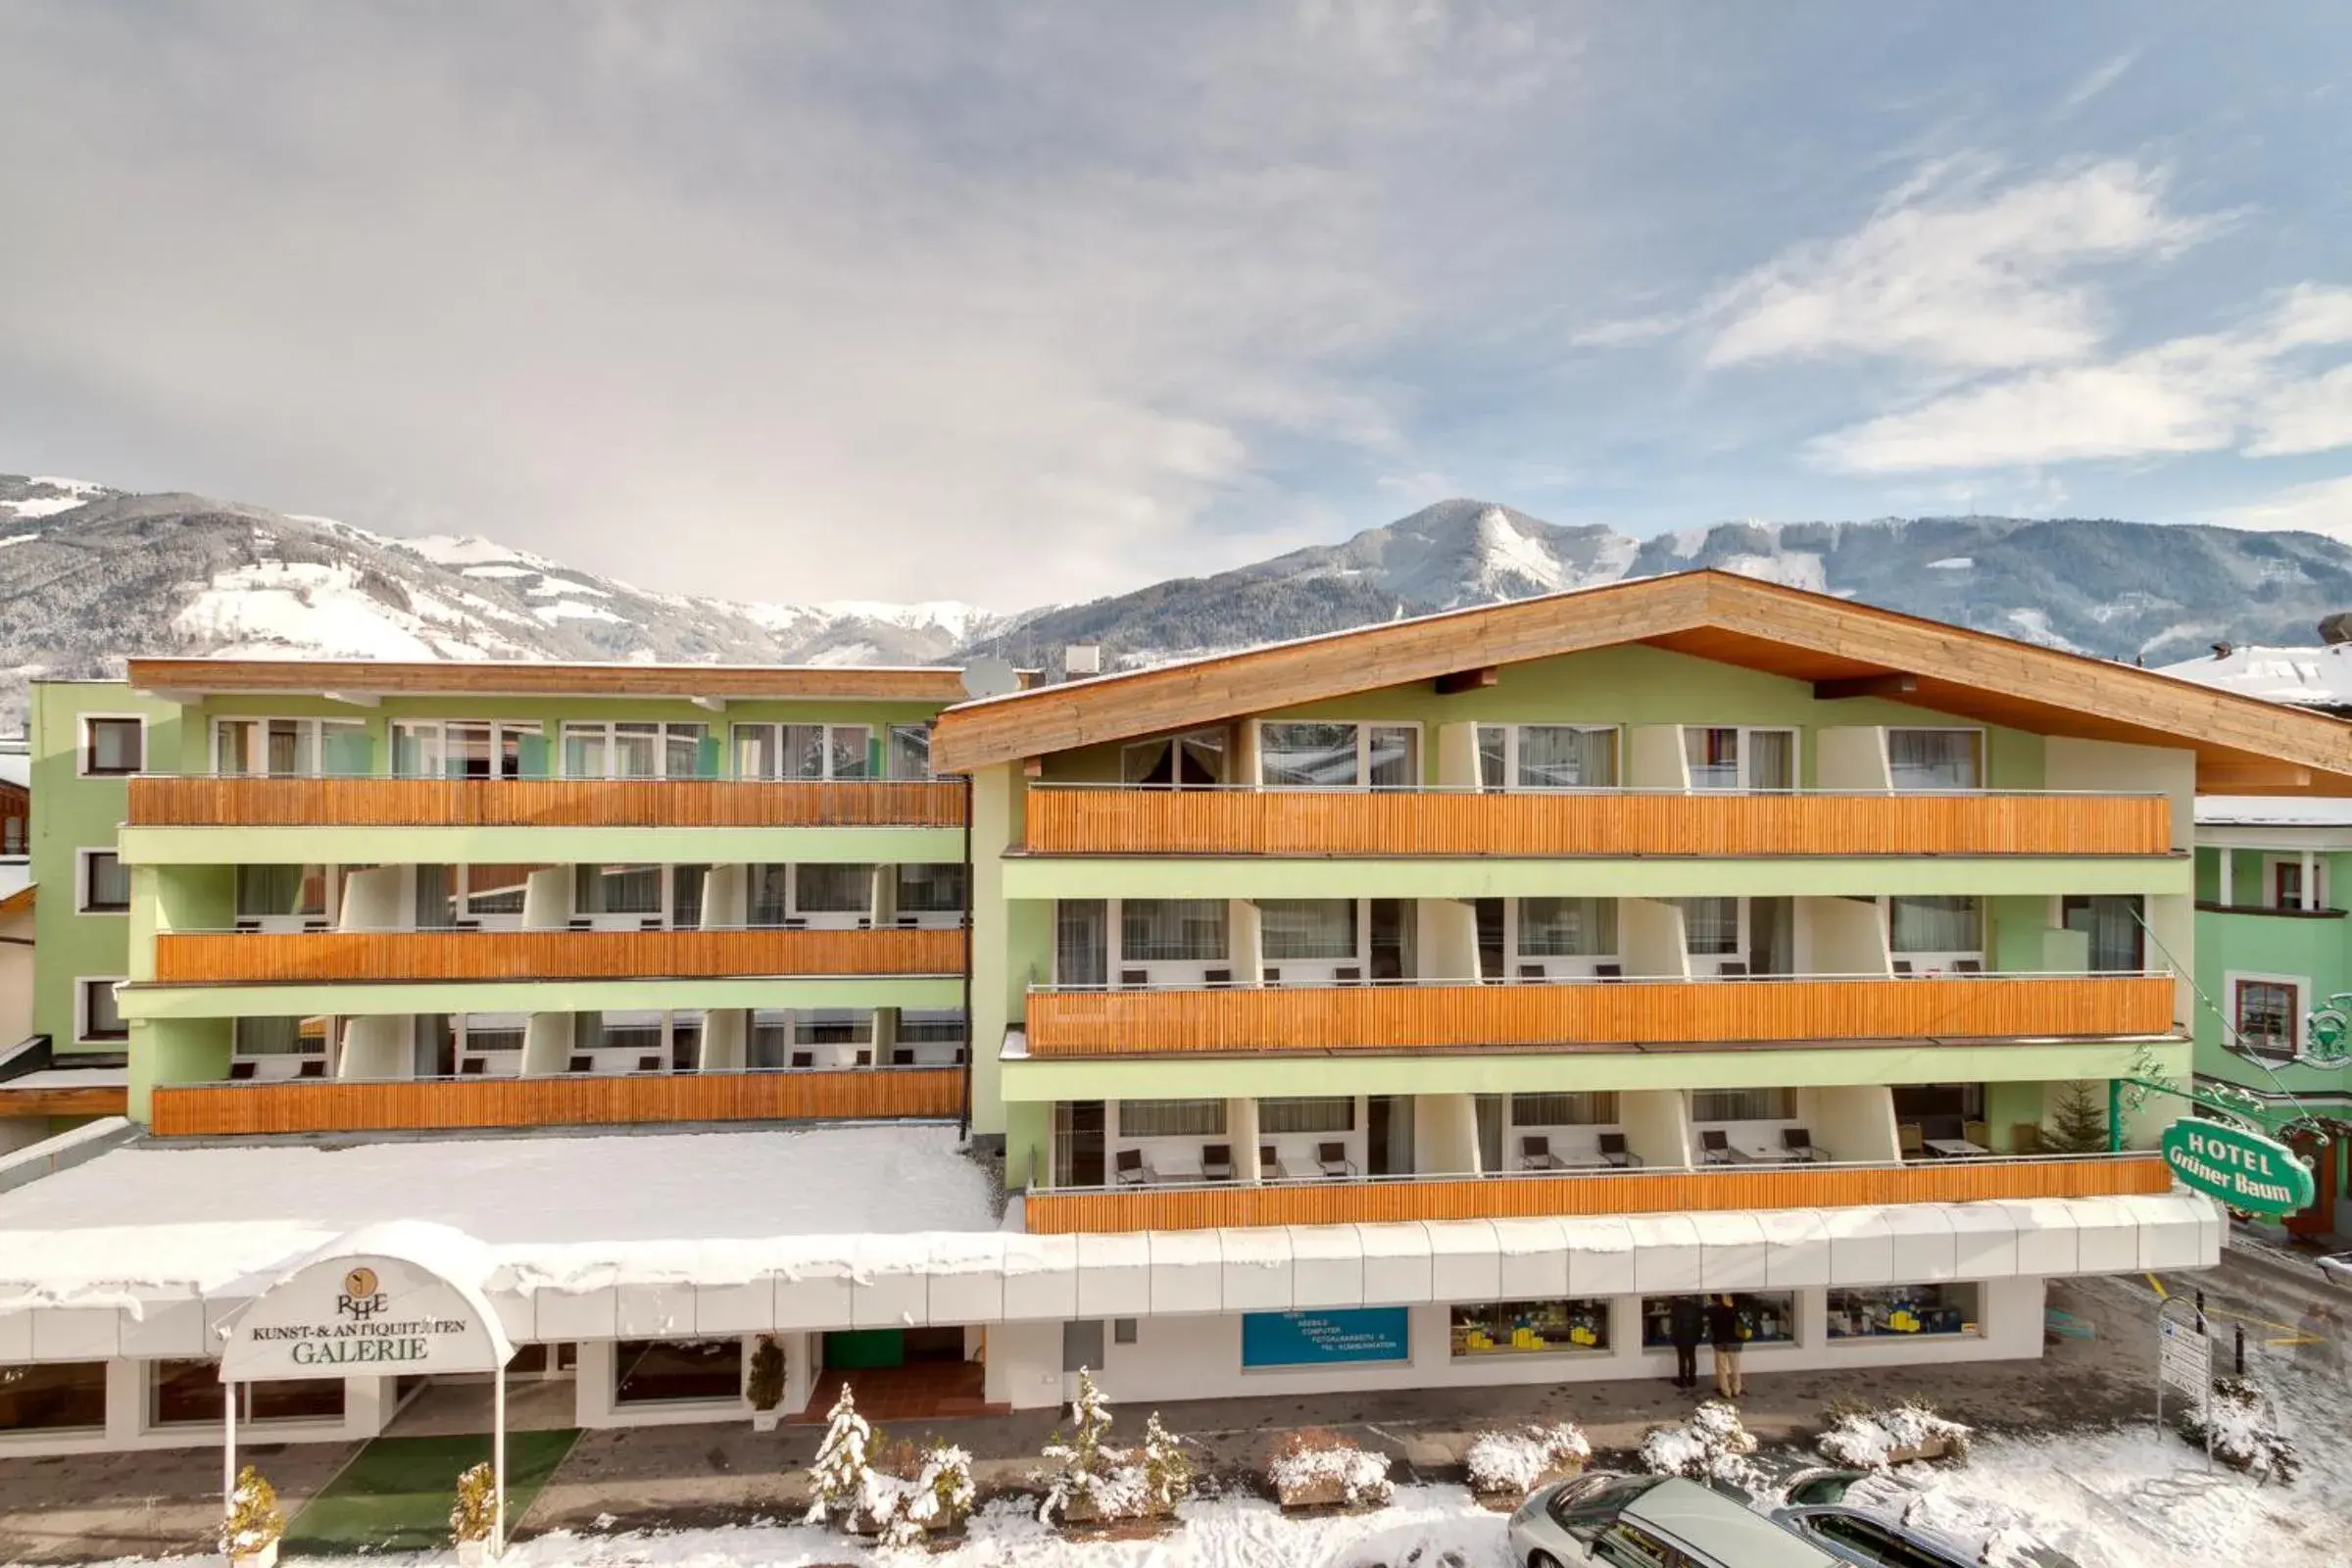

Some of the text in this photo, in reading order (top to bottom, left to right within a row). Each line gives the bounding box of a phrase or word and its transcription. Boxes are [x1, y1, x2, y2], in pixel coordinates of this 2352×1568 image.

[2188, 1133, 2273, 1176] HOTEL
[2170, 1145, 2292, 1203] Grüner Baum
[252, 1324, 315, 1342] KUNST-
[316, 1327, 330, 1339] &
[292, 1337, 429, 1365] GALERIE
